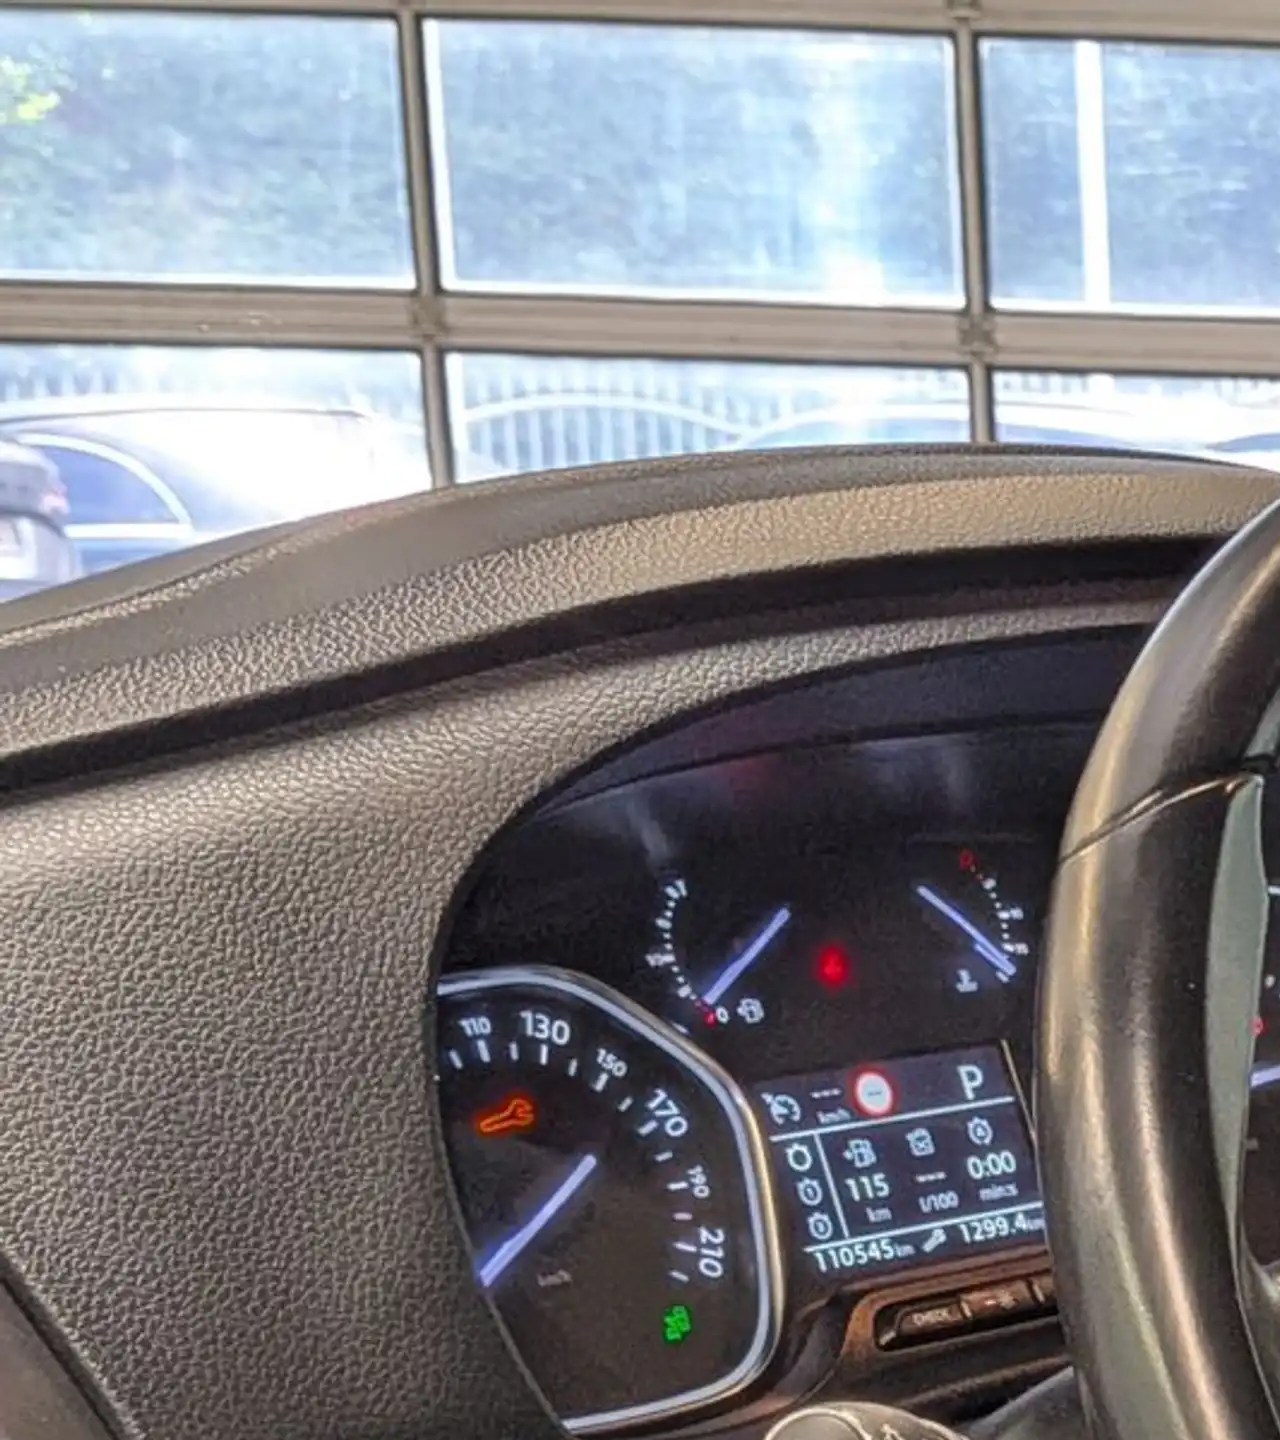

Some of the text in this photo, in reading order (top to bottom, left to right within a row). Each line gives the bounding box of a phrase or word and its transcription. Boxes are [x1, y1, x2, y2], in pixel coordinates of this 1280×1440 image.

[459, 1015, 492, 1037] 110
[520, 1010, 570, 1046] 130
[715, 1005, 730, 1024] 0
[596, 1047, 628, 1078] 150
[956, 1064, 984, 1100] P
[648, 1087, 688, 1138] 170
[686, 1165, 711, 1199] 190
[966, 1150, 1017, 1180] 0:00
[844, 1172, 891, 1203] 115
[698, 1226, 726, 1279] 210
[813, 1238, 895, 1274] 110545
